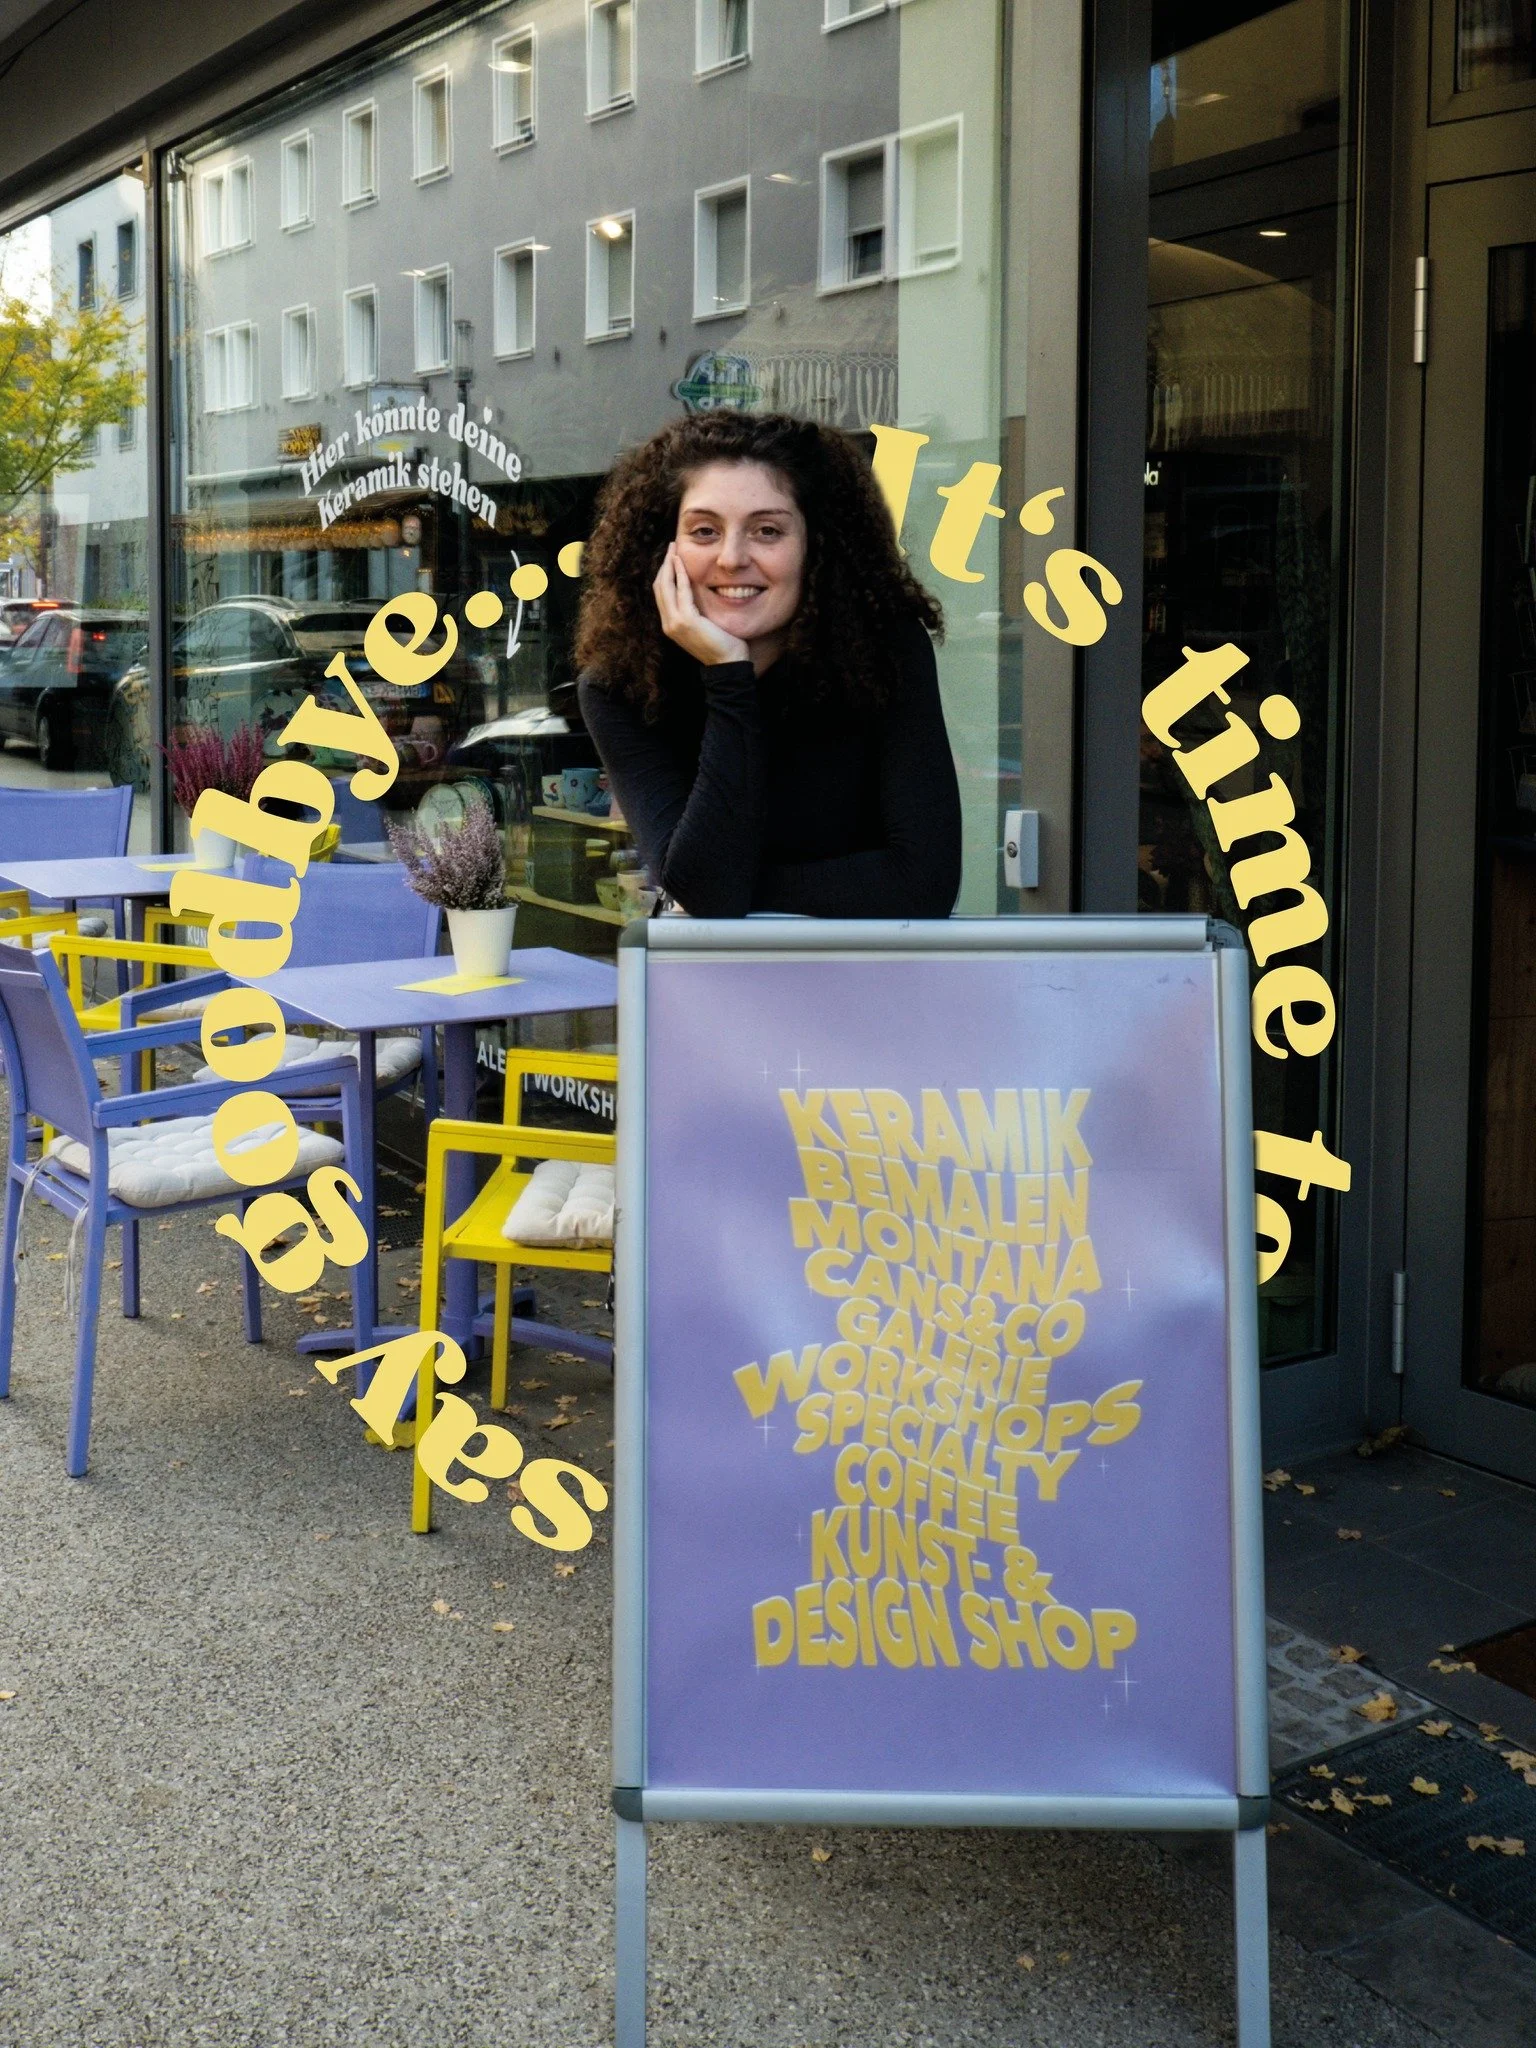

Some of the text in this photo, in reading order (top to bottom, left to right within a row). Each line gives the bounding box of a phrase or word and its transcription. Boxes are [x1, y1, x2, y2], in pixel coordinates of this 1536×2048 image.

[300, 430, 350, 497] Hier
[354, 396, 440, 445] könnte
[448, 402, 522, 482] deine
[317, 451, 498, 532] Keramik stehen
[779, 1087, 1093, 1172] KERAMIK
[797, 1145, 1090, 1244] BEMALEN
[788, 1197, 1101, 1305] MONTANA
[804, 1248, 1086, 1357] CANS&CO
[836, 1297, 1053, 1405] GALERIE
[732, 1340, 1144, 1453] WORKSHOPS
[793, 1391, 1081, 1501] SPECIALTY
[834, 1442, 1020, 1545] COFFEE
[811, 1505, 1060, 1606] KUNST- &
[752, 1577, 1138, 1671] DESIGN SHOP
